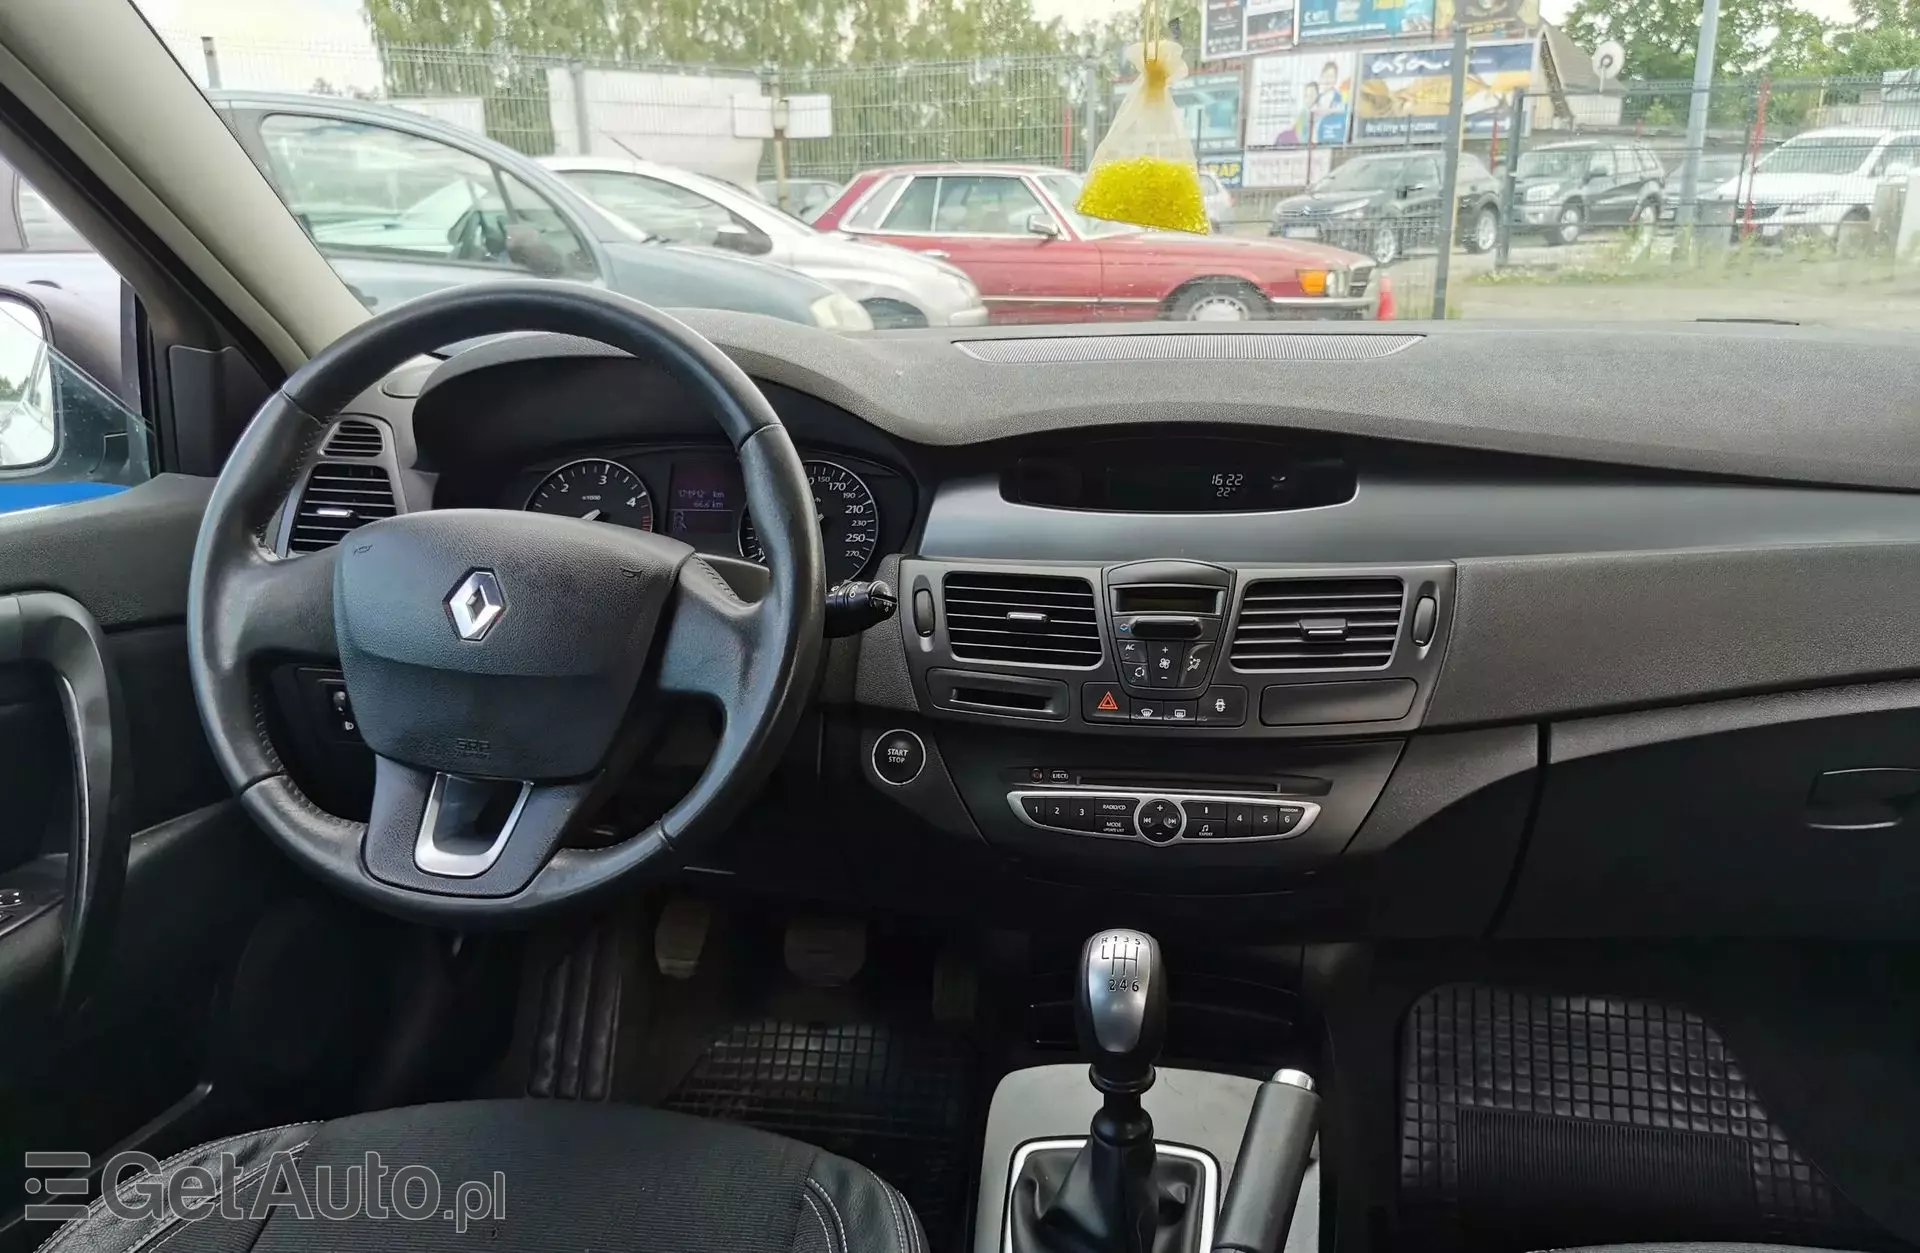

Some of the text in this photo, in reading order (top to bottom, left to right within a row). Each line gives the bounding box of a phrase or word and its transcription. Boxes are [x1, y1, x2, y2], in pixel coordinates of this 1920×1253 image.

[598, 475, 608, 485] 3
[560, 484, 569, 493] 2
[829, 482, 846, 491] 170
[626, 497, 637, 507] 4
[845, 504, 864, 514] 210
[851, 519, 867, 527] 230
[845, 533, 866, 543] 250
[1125, 643, 1135, 651] AC
[887, 748, 909, 757] START
[1034, 805, 1039, 813] 1
[1054, 806, 1060, 815] 2
[1079, 808, 1085, 816] 3
[1236, 814, 1243, 822] 4
[1262, 815, 1268, 823] 5
[1284, 815, 1290, 823] 6
[1109, 979, 1139, 992] 2 4 6
